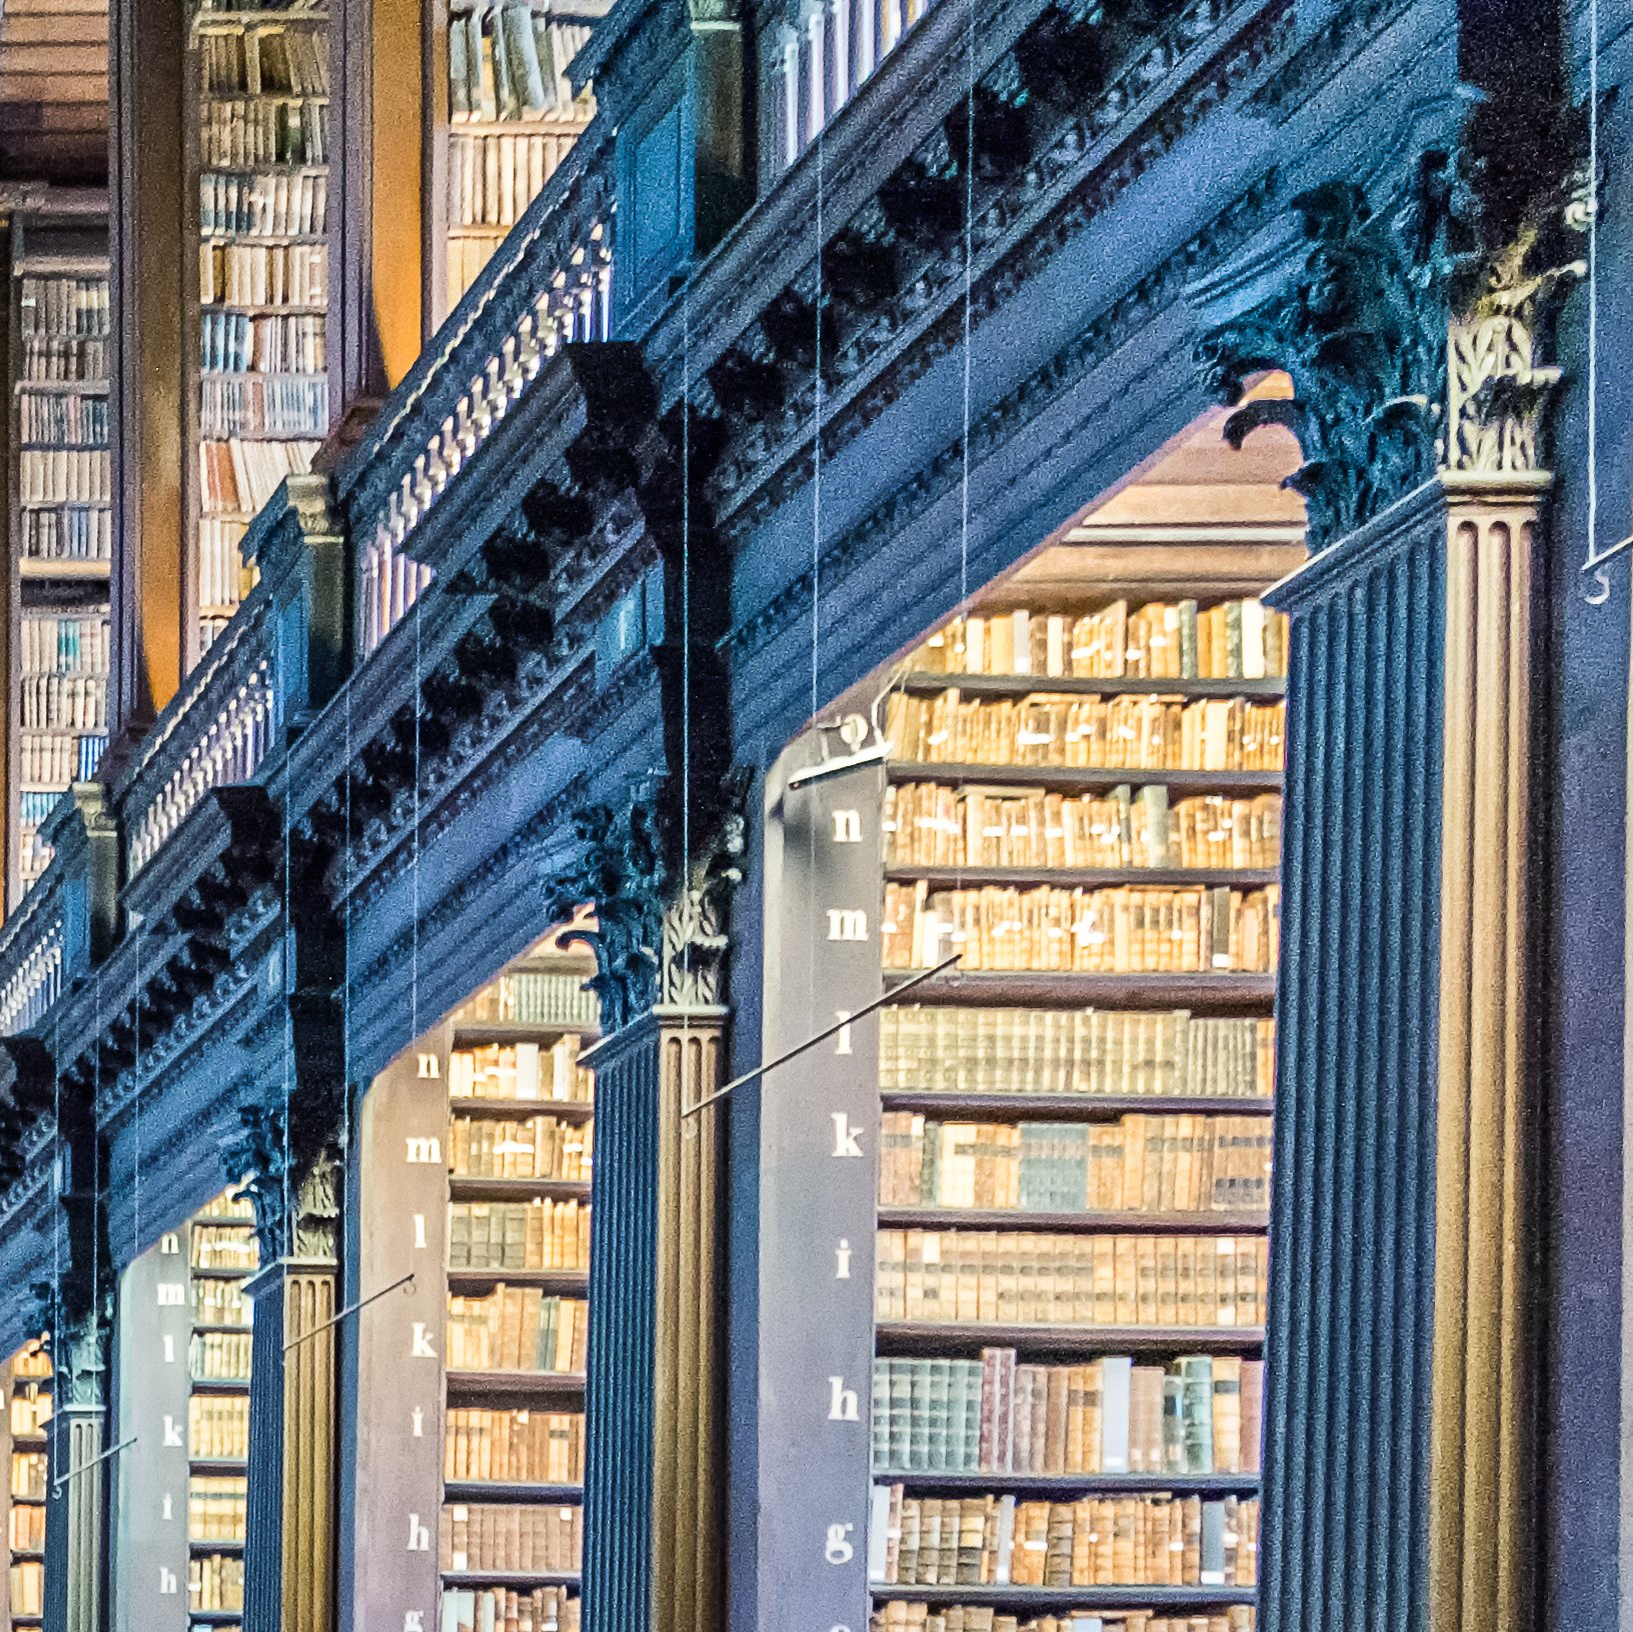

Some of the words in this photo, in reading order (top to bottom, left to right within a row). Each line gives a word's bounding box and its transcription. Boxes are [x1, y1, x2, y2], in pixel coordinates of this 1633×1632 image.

[832, 809, 863, 842] n
[827, 909, 869, 941] m
[835, 1010, 852, 1055] l
[417, 1053, 440, 1079] n
[406, 1137, 442, 1163] m
[831, 1112, 864, 1157] k
[413, 1213, 427, 1248] l
[835, 1238, 852, 1279] i
[411, 1322, 437, 1357] k
[828, 1376, 860, 1421] h
[412, 1406, 423, 1437] i
[407, 1513, 430, 1551] h
[825, 1522, 853, 1565] g
